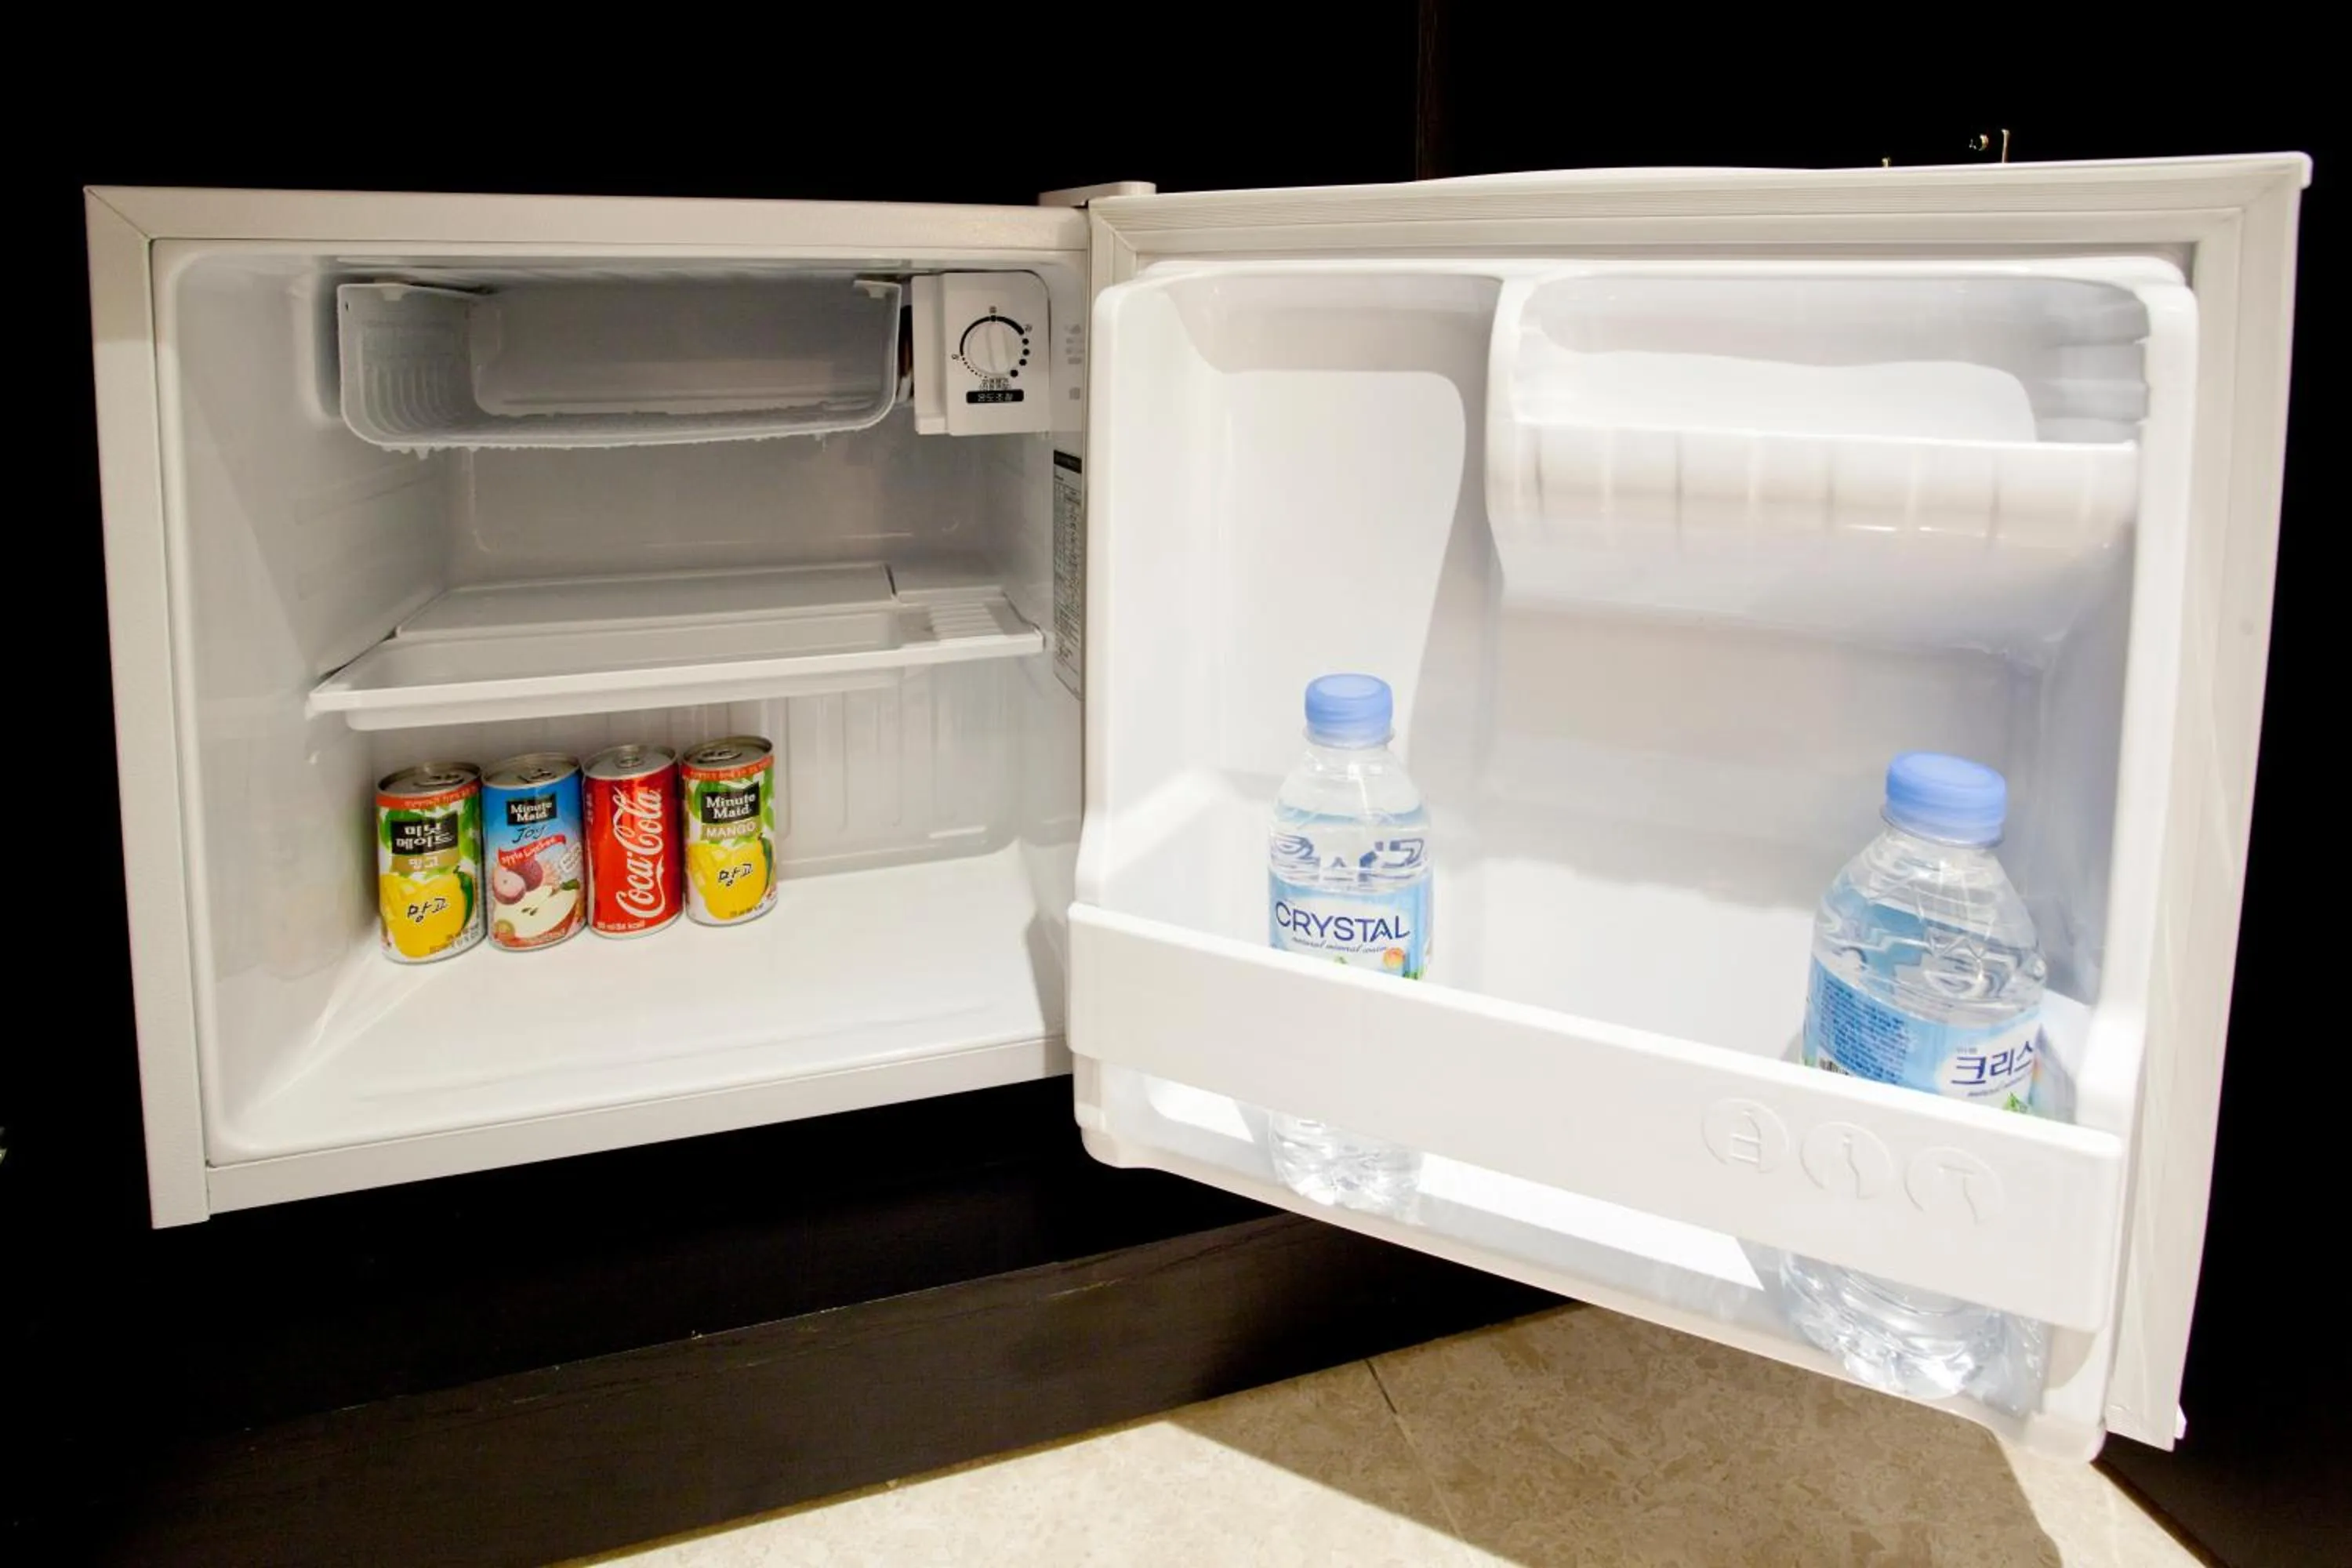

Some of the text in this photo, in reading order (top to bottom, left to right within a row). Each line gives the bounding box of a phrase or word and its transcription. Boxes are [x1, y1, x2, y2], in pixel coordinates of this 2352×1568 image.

[511, 802, 553, 814] Minute
[706, 793, 756, 808] Minute
[517, 812, 550, 822] Maid
[713, 804, 752, 819] Maid
[404, 822, 441, 837] 미닛
[512, 826, 547, 844] Joy
[706, 821, 757, 839] MANGO
[396, 833, 452, 850] 메이트
[612, 786, 666, 919] Coca-Cola
[717, 862, 753, 887] 망고
[407, 897, 448, 923] 망고
[1275, 901, 1410, 943] CRYSTAL
[1950, 1040, 2034, 1085] 크리스
